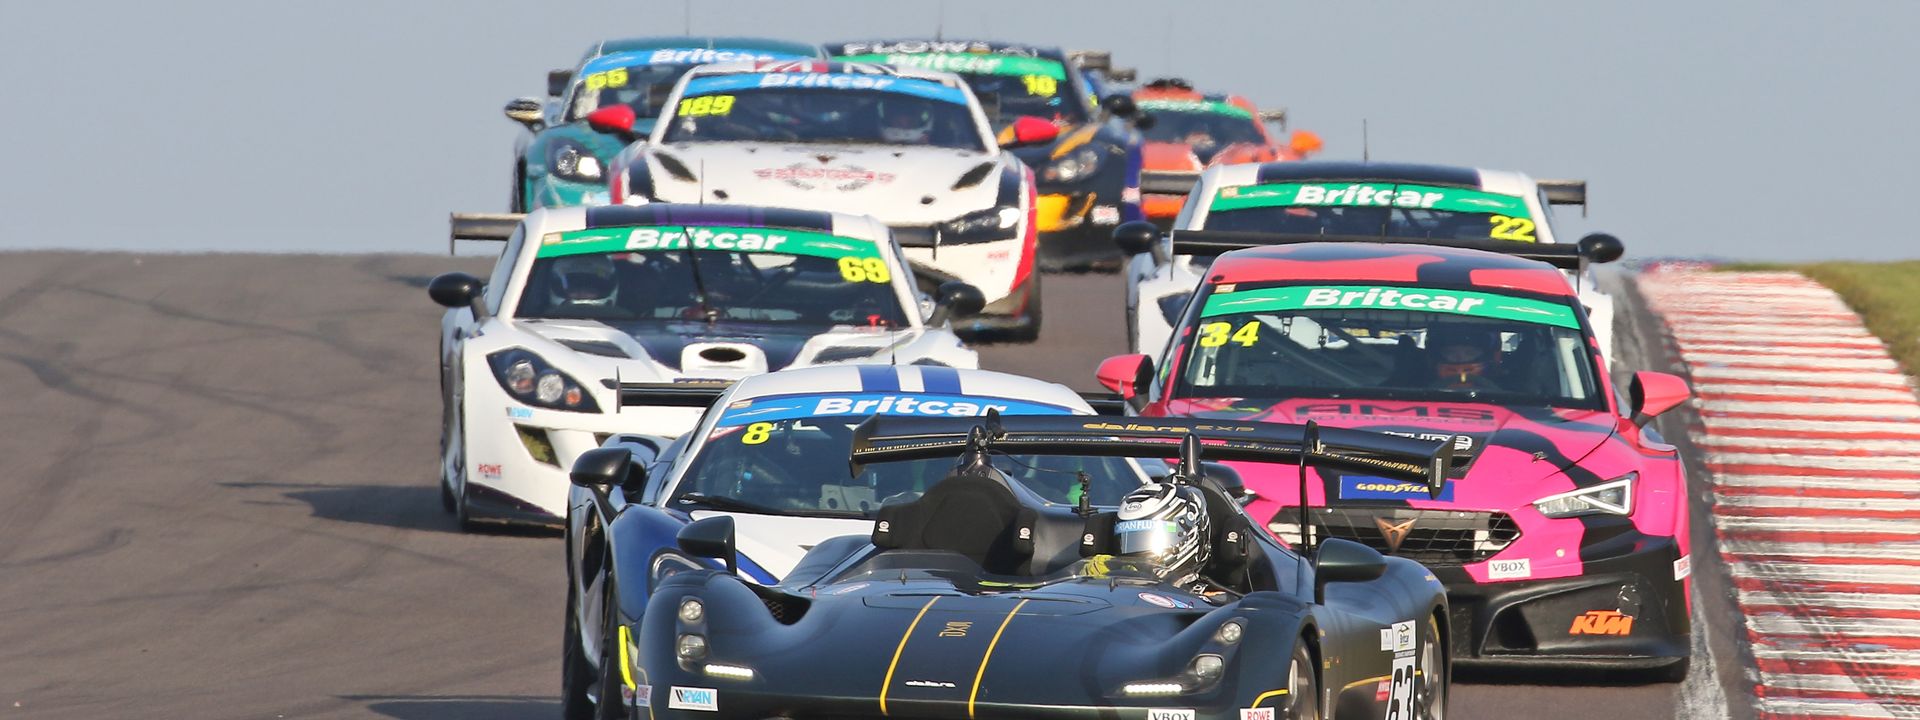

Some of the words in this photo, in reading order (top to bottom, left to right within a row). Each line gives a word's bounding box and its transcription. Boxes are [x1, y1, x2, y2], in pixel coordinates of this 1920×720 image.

[759, 72, 895, 90] Britcar
[678, 95, 736, 117] 189
[1293, 184, 1444, 209] Britcar
[625, 226, 787, 250] Britcar
[1488, 215, 1536, 243] 22
[838, 256, 891, 283] 69
[1302, 287, 1485, 312] Britcar
[1200, 321, 1261, 347] 34
[813, 396, 1007, 417] Britcar
[1295, 403, 1494, 420] AMS
[741, 421, 773, 445] 8
[1356, 482, 1431, 494] GOODYEA
[1492, 561, 1526, 572] VBOX
[1569, 610, 1633, 635] KTM
[1152, 712, 1190, 720] VBOX
